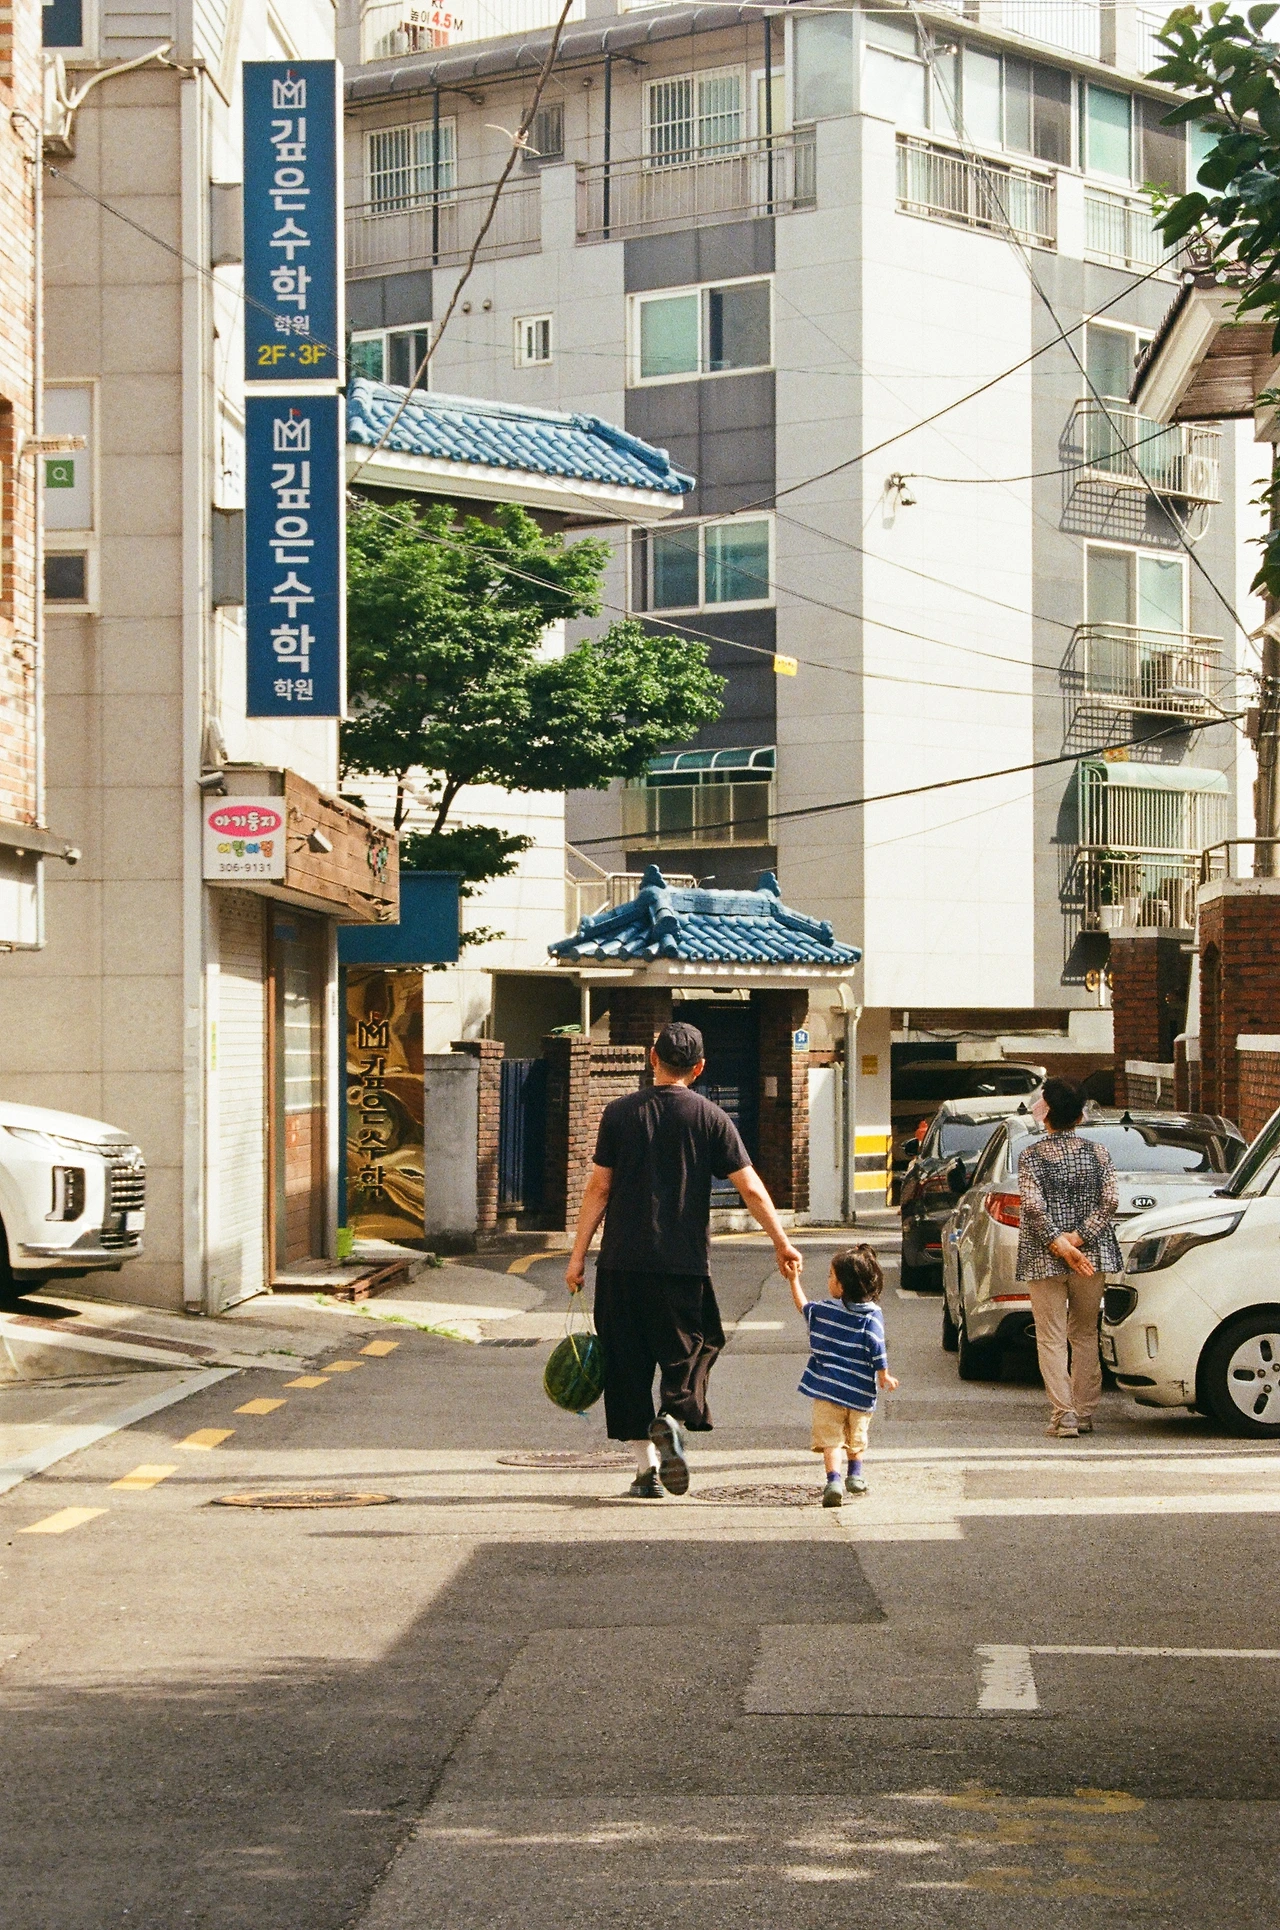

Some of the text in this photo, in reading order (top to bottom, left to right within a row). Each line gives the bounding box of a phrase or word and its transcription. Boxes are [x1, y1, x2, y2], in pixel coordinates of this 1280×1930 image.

[269, 117, 311, 310] 깊은수학
[274, 315, 310, 335] 학원
[269, 461, 315, 673] 깊은수학
[274, 678, 313, 701] 학원
[214, 811, 276, 832] 아기둥지
[219, 863, 272, 872] 306-9131
[359, 1057, 387, 1198] 깊은수학
[1134, 1198, 1154, 1206] KIA
